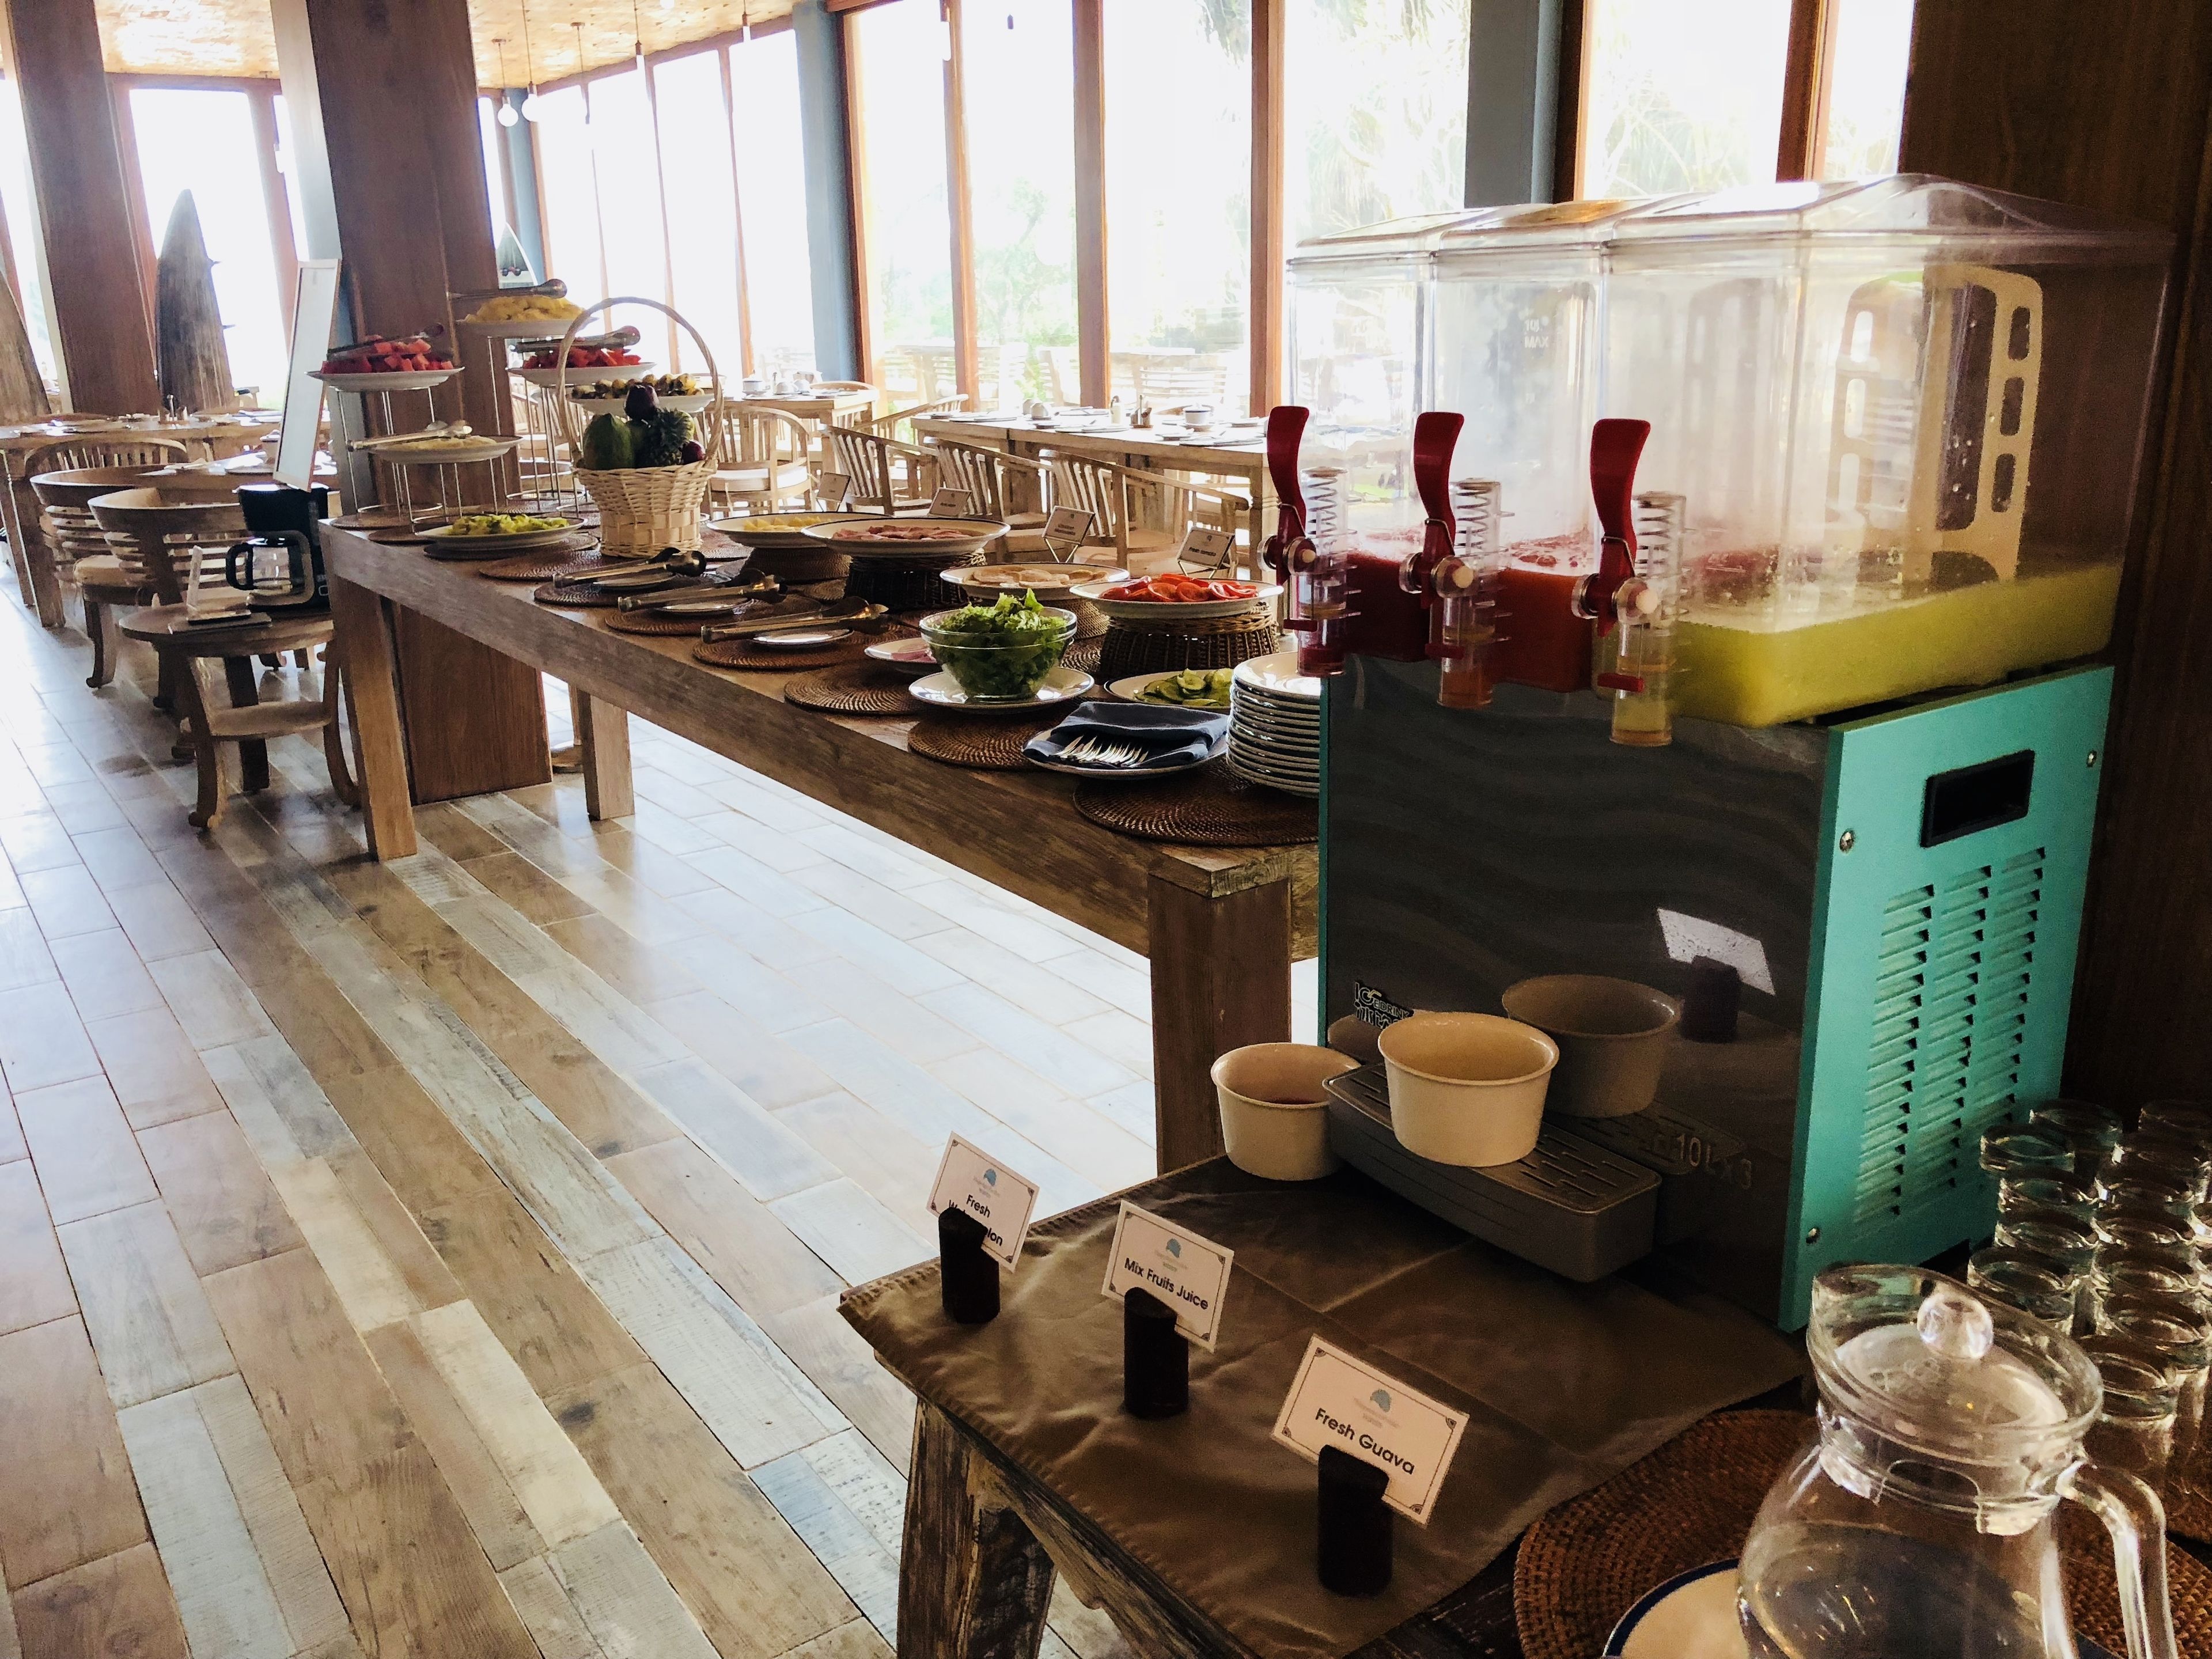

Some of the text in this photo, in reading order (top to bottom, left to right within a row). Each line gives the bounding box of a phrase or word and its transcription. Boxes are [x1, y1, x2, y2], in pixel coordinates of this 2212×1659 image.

[1524, 336, 1548, 348] MAX
[966, 1194, 990, 1218] Fresh
[1124, 1257, 1144, 1277] Mix
[1147, 1268, 1174, 1293] Fruits
[1177, 1285, 1209, 1309] Juice
[1315, 1407, 1355, 1440] Fresh
[1359, 1434, 1415, 1475] Guava
